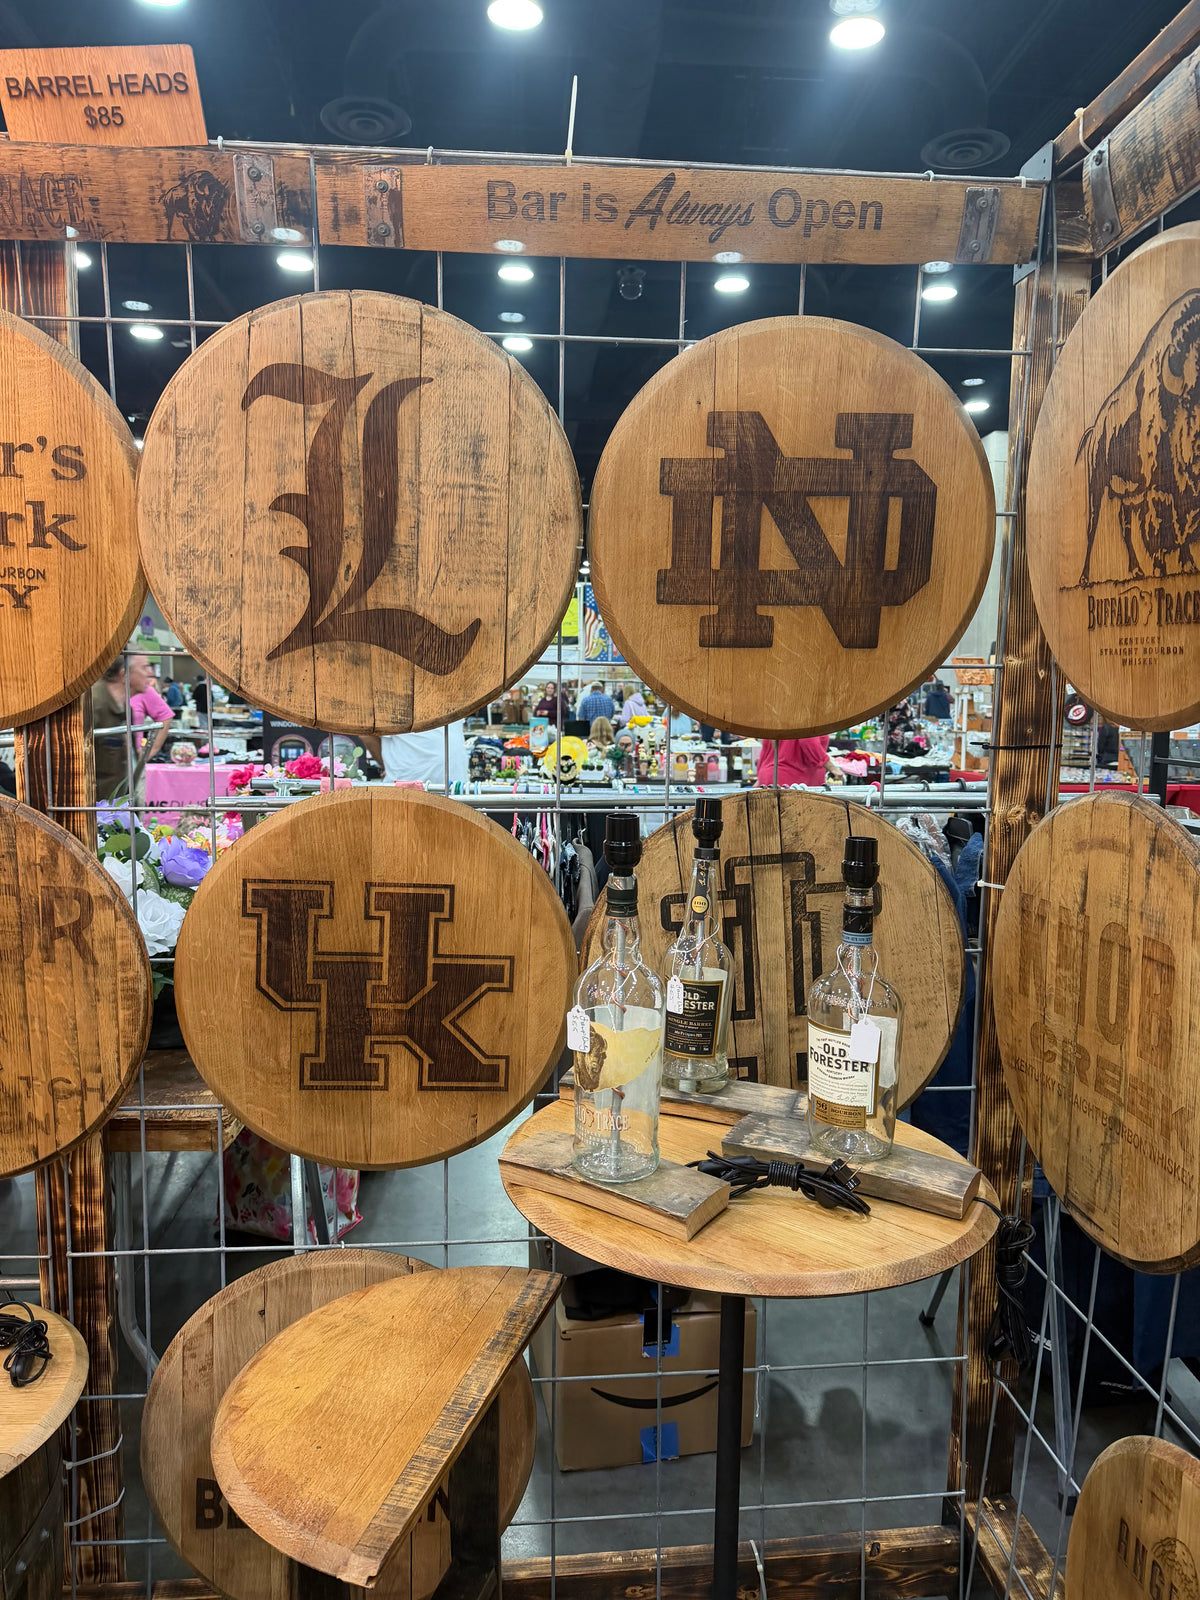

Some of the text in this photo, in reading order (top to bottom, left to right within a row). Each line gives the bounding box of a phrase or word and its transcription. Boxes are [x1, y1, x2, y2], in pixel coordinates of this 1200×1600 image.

[5, 72, 189, 99] BARREL HEADS
[84, 105, 124, 130] $85
[487, 172, 883, 243] Bar is Always Open
[1088, 587, 1200, 631] BUFFALO TRACE
[1099, 645, 1184, 656] STRAIGHT BOURBON
[683, 990, 700, 1001] OLD
[684, 1000, 716, 1011] ESTER
[809, 1046, 870, 1073] FORESTER
[823, 1042, 847, 1058] OLD
[595, 1110, 630, 1132] TRACE
[1014, 1056, 1056, 1092] KENTUCKY
[1148, 1144, 1195, 1189] WHISKEY
